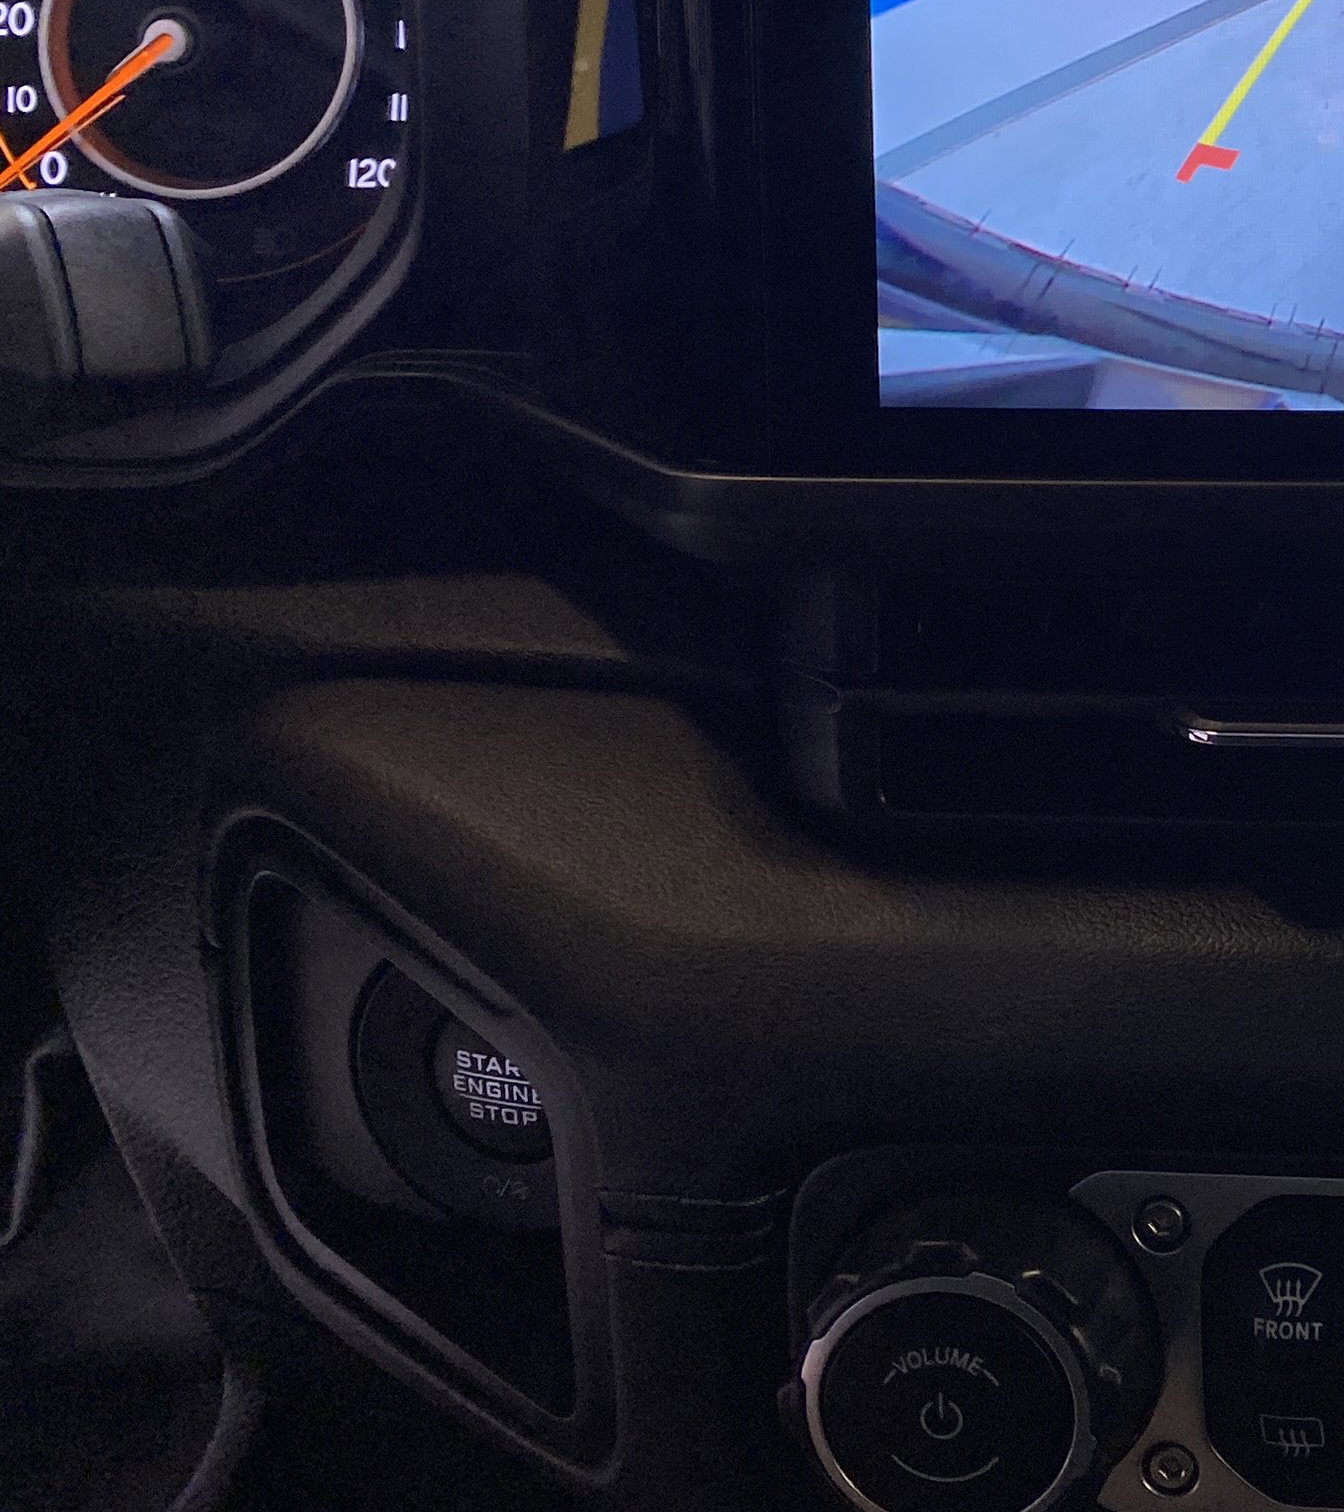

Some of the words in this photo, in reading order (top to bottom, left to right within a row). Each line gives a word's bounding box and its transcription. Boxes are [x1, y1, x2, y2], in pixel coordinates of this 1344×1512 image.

[7, 85, 38, 113] 10
[39, 150, 68, 186] 0
[348, 157, 397, 188] 120
[456, 1050, 521, 1077] STAR
[469, 1102, 538, 1126] STOP
[1254, 1318, 1324, 1341] FRONT
[892, 1346, 983, 1377] VOLUME
